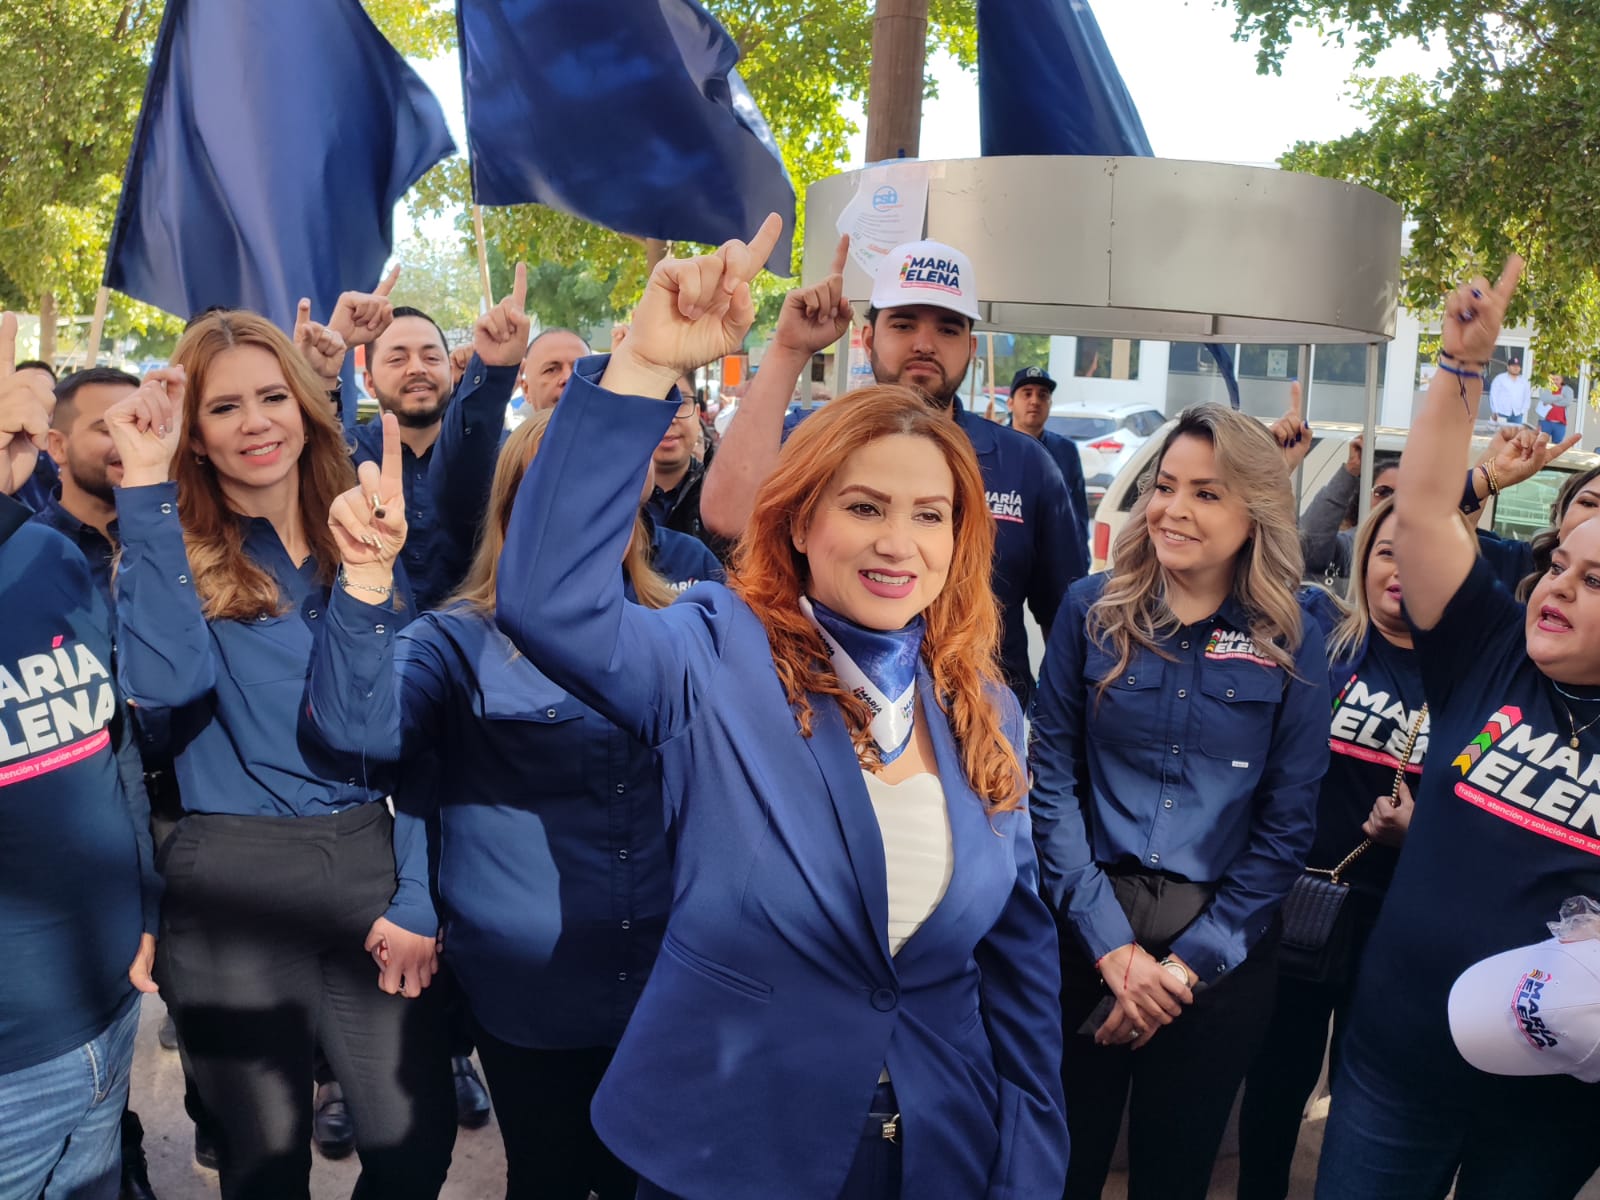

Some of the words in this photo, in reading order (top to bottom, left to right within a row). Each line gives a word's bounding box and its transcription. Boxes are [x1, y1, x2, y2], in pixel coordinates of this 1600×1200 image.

[905, 269, 959, 288] ELENA
[910, 257, 960, 275] MARÍA
[987, 503, 1022, 518] ENA
[0, 763, 34, 781] tención
[34, 763, 40, 772] y
[40, 751, 72, 768] solución
[1458, 785, 1486, 806] Trabajo,
[1487, 800, 1524, 822] atención
[1524, 817, 1531, 825] y
[1531, 818, 1567, 838] solución
[1568, 833, 1585, 845] con
[1516, 978, 1546, 1047] ELENA
[1529, 980, 1559, 1047] MARÍA
